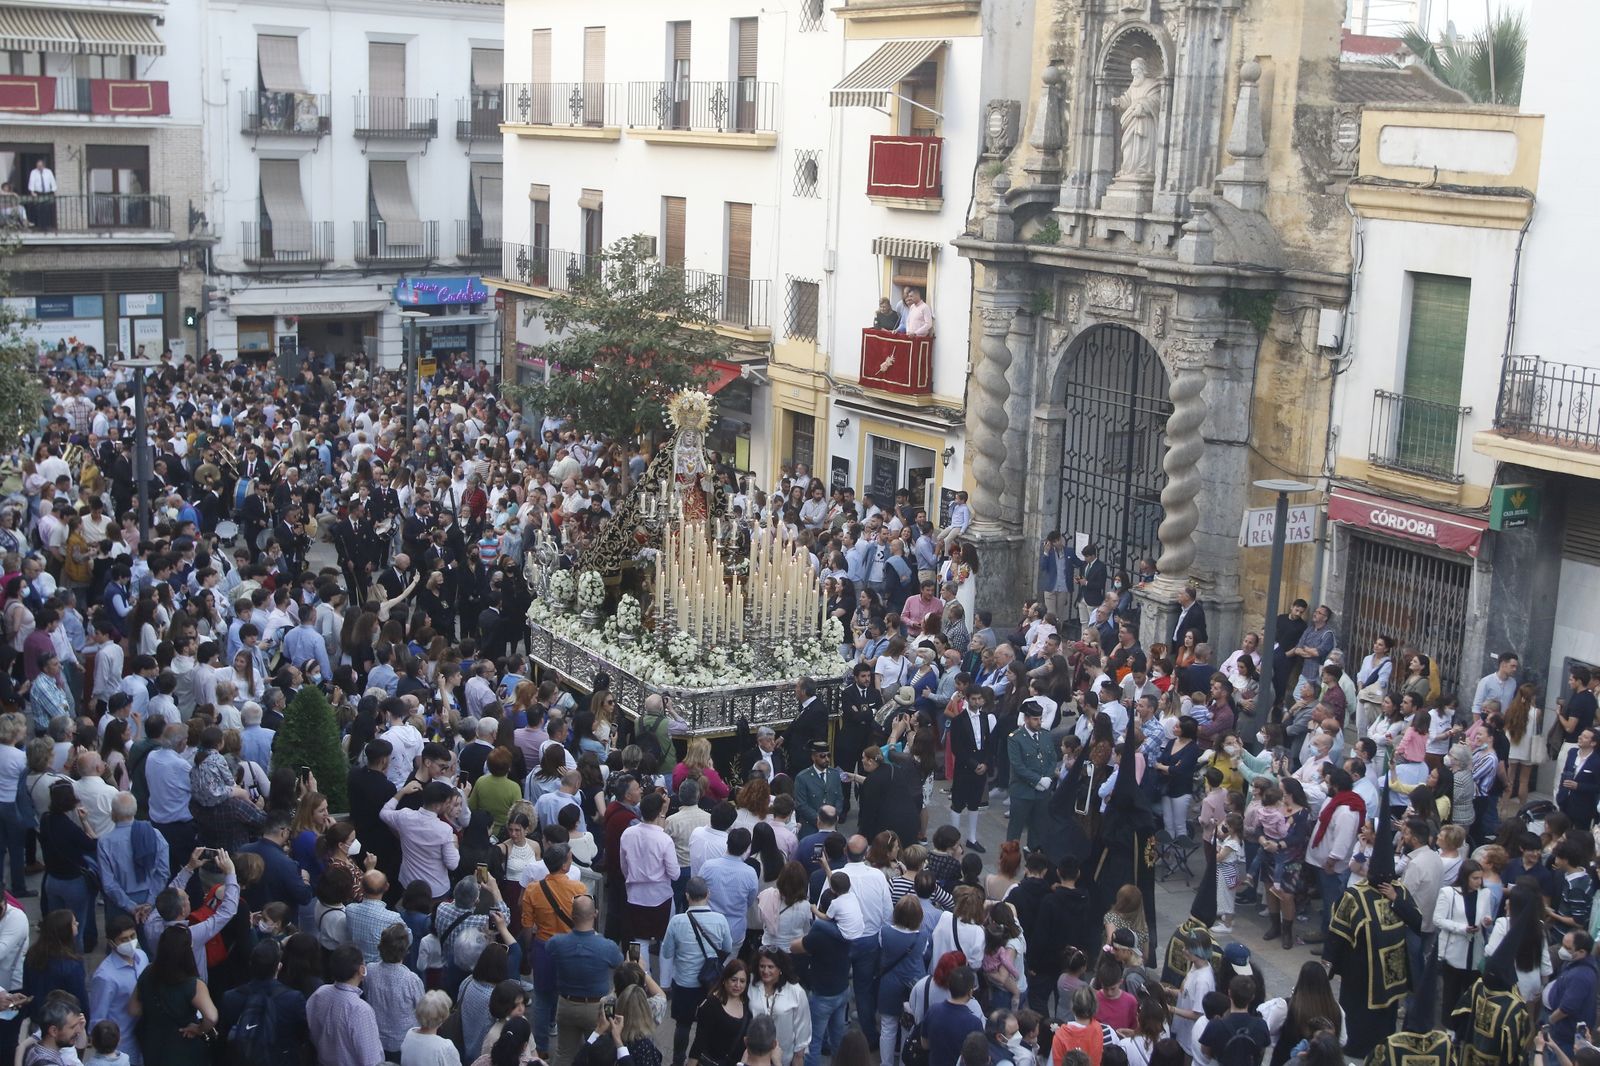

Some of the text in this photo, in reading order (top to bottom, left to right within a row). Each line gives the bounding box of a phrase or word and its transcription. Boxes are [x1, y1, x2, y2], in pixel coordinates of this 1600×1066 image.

[1258, 510, 1307, 526] PRSA
[1370, 509, 1436, 538] CÓRDOBA
[1252, 526, 1311, 543] REVTAS
